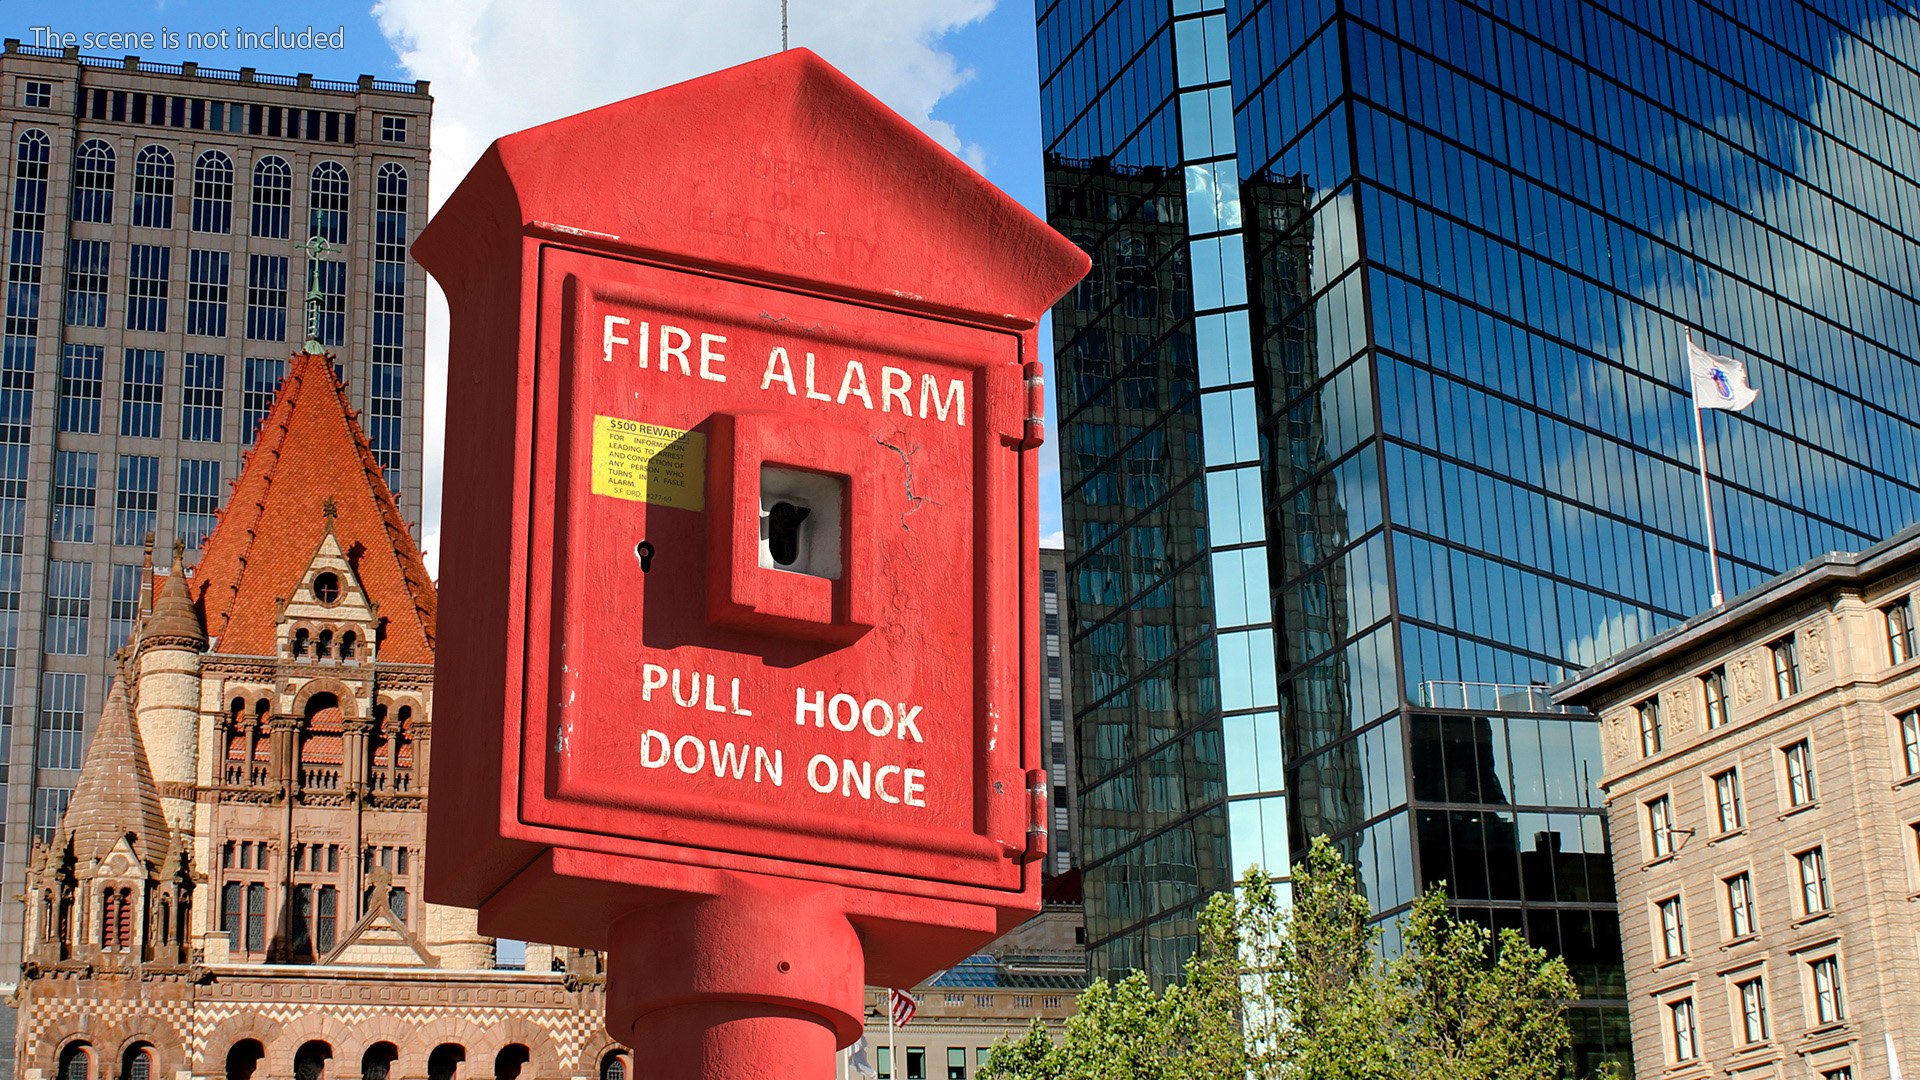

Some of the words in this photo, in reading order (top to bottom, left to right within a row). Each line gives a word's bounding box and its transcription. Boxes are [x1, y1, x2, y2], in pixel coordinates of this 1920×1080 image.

[772, 190, 803, 213] OF
[602, 314, 728, 383] FIRE
[759, 345, 967, 427] ALARM
[610, 419, 637, 432] $500
[639, 424, 686, 440] REWARD
[609, 433, 625, 442] FOR
[633, 437, 685, 452] INFORMATION
[609, 442, 642, 453] LEADING
[657, 450, 685, 460] ARREST
[608, 451, 626, 459] AND
[626, 453, 673, 468] CONVICTION
[674, 462, 685, 470] OF
[608, 459, 624, 468] ANY
[630, 463, 660, 474] PERSON
[665, 469, 684, 478] WHO
[608, 468, 633, 479] TURNS
[663, 477, 685, 488] FASLE
[641, 663, 753, 717] PULL
[795, 687, 925, 743] HOOK
[639, 729, 783, 787] DOWN
[806, 753, 927, 808] ONCE
